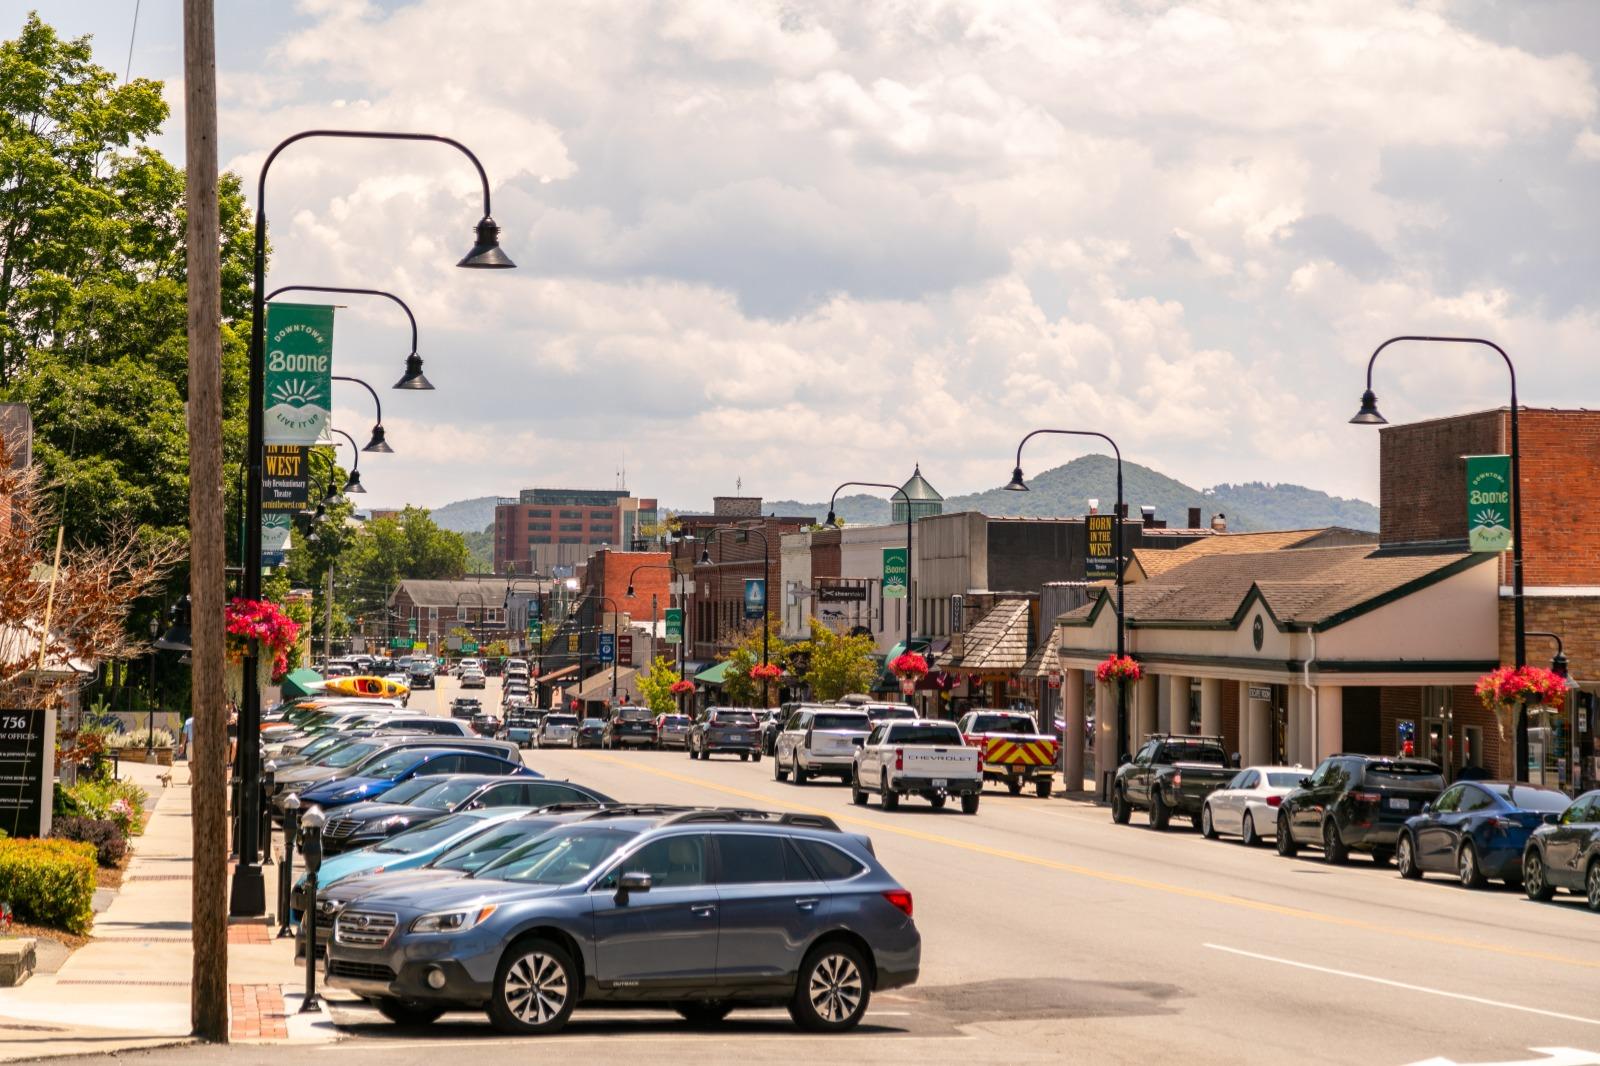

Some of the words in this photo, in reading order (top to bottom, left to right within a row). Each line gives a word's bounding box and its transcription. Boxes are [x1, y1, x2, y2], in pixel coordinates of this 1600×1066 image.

[274, 324, 324, 344] DOWNTOWN
[268, 350, 328, 372] Boone
[277, 412, 294, 429] LIVE
[298, 421, 307, 429] IT
[308, 413, 320, 425] UP
[265, 456, 301, 477] WEST
[272, 479, 305, 488] Revolutionary
[273, 490, 292, 498] Theatre
[1470, 490, 1508, 505] Boone
[262, 500, 307, 510] orninthewest.com
[1089, 517, 1112, 530] HORN
[1090, 531, 1098, 542] IN
[1098, 531, 1111, 542] THE
[1089, 543, 1112, 556] WEST
[2, 716, 26, 729] 756
